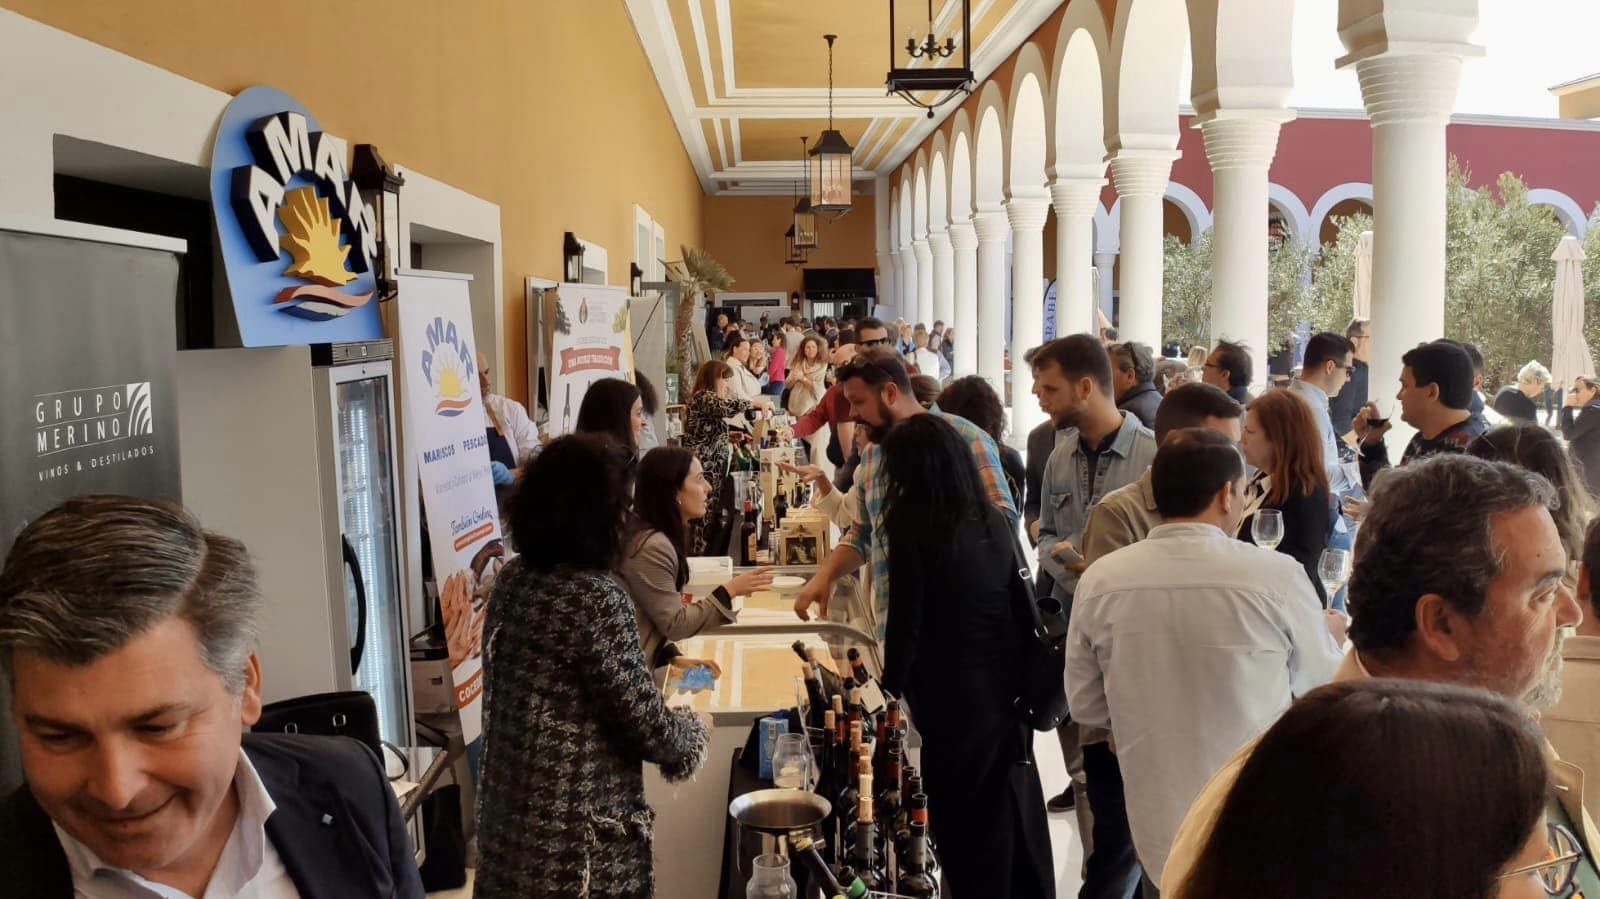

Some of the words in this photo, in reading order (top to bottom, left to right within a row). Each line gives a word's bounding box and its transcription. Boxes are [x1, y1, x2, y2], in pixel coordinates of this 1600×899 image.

[234, 111, 378, 272] AMAR
[421, 316, 474, 387] AMAR
[36, 392, 121, 423] GRUPO
[37, 418, 120, 453] MERINO
[38, 463, 69, 481] VINOS
[76, 460, 82, 472] &
[91, 445, 155, 468] DESTILADOS
[423, 443, 456, 464] MARISCOS
